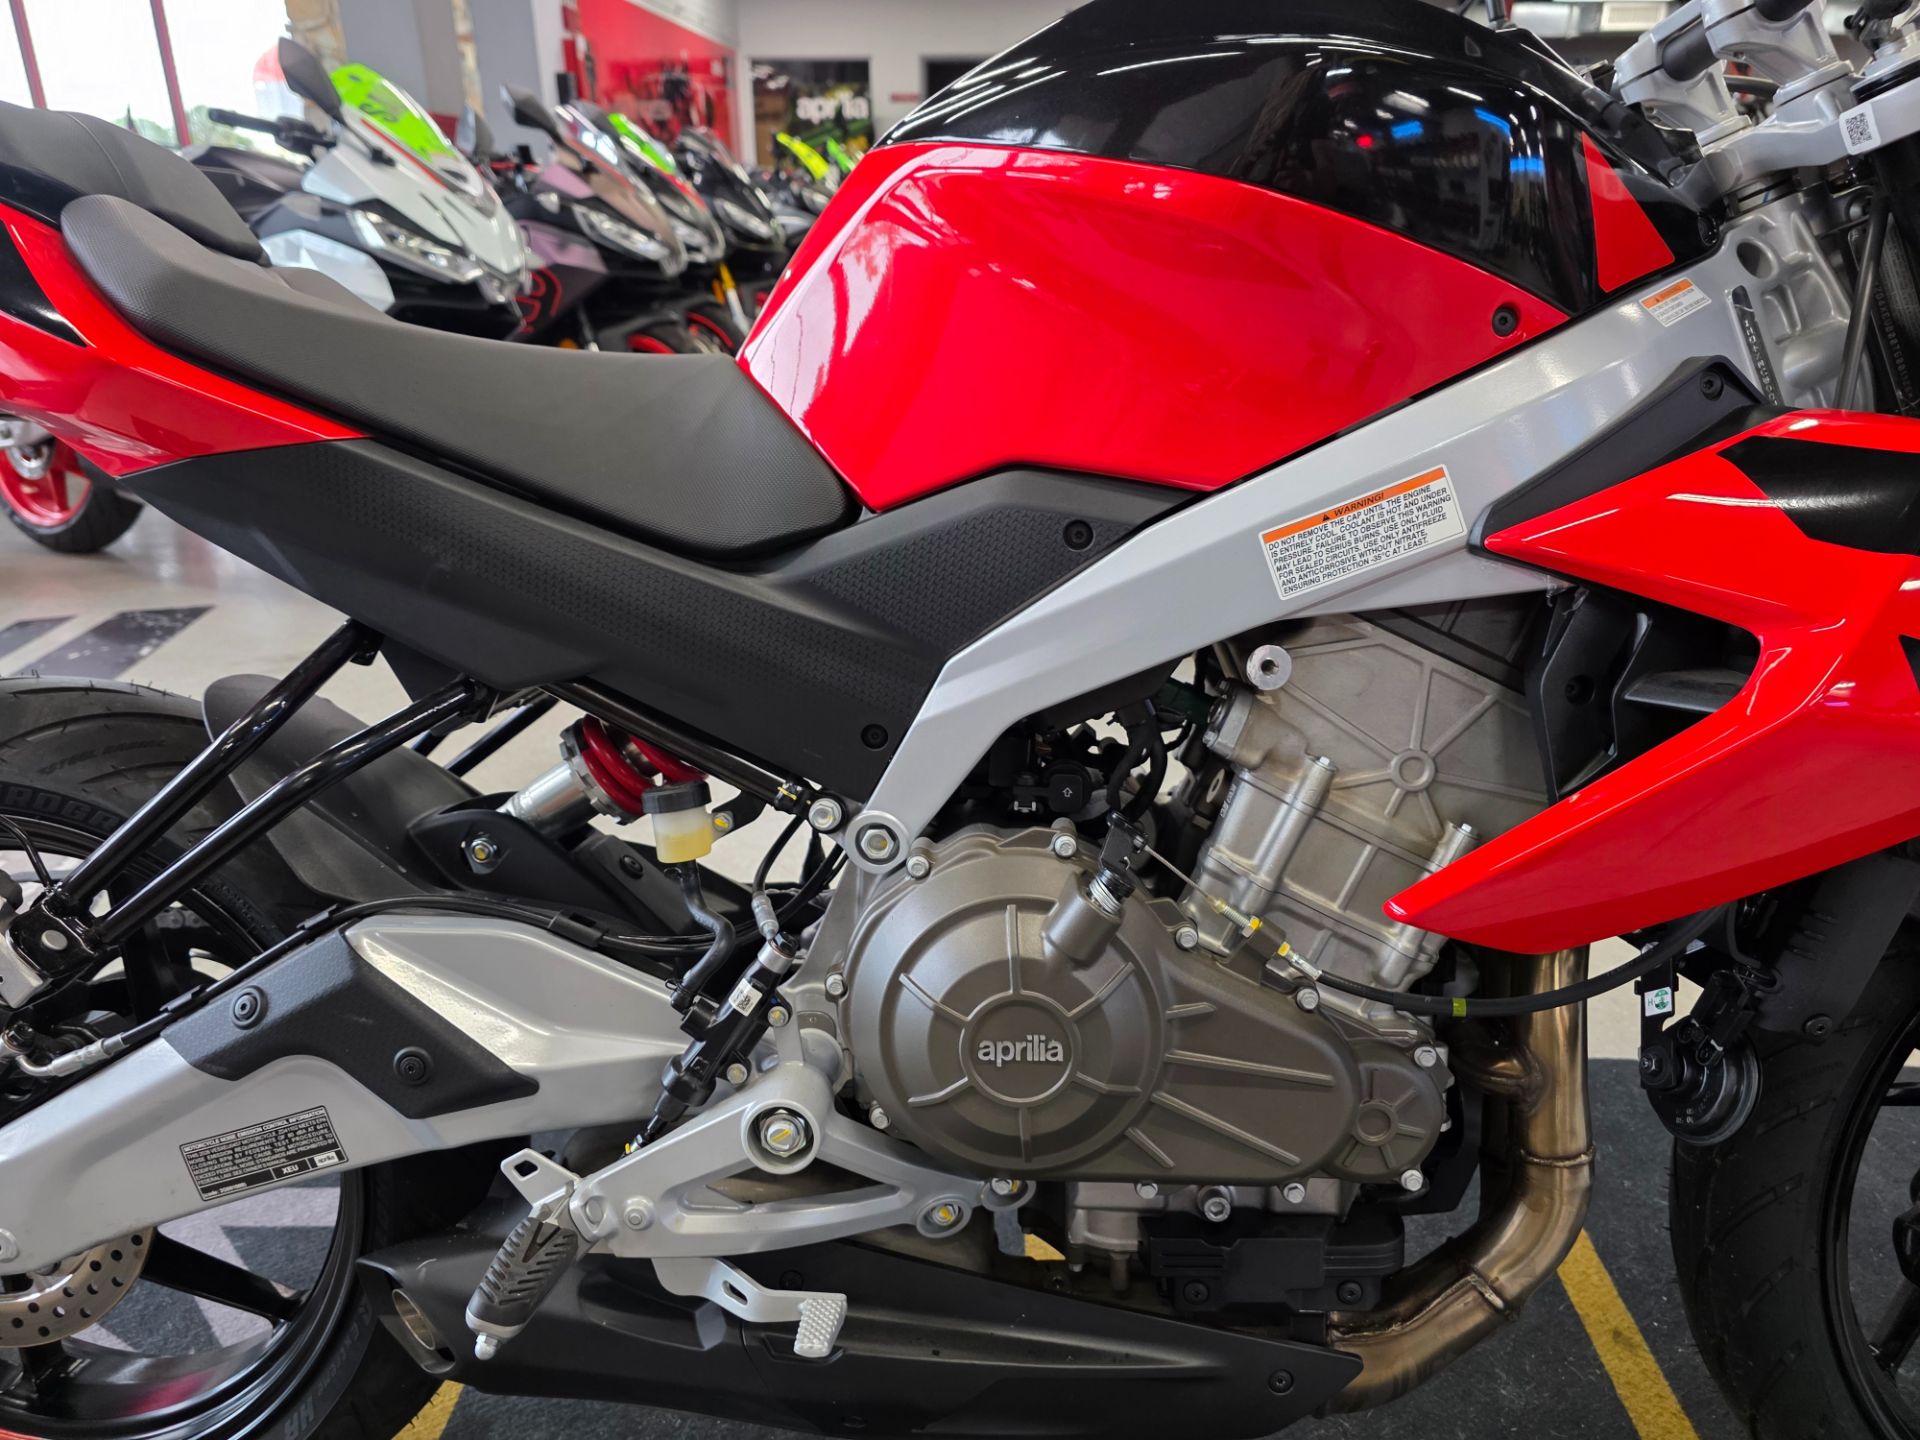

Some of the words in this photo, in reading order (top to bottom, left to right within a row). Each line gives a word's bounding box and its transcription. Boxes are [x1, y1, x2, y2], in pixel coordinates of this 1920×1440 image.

[1270, 542, 1278, 551] DO
[1281, 535, 1295, 546] NOT
[1298, 523, 1328, 540] REMOVE
[1331, 517, 1344, 528] THE
[1347, 511, 1360, 522] CAP
[1364, 502, 1383, 515] UNTIL
[1387, 496, 1400, 507] THE
[1404, 485, 1430, 500] ENGINE
[1272, 550, 1277, 558] IS
[1280, 537, 1312, 555] ENTIRELY
[1316, 528, 1336, 542] COOL.
[1340, 514, 1375, 533] COOLANT
[1378, 511, 1383, 519] IS
[1386, 504, 1401, 515] HOT
[1404, 498, 1418, 509] AND
[1422, 487, 1446, 502] UNDER
[1274, 545, 1313, 566] PRESSURE.
[1316, 533, 1345, 550] FAILURE
[1349, 529, 1357, 538] TO
[1361, 515, 1395, 533] OBSERVE
[1398, 508, 1413, 519] THIS
[1416, 494, 1450, 513] WARNING
[1335, 493, 1383, 516] WARNING!
[1277, 562, 1291, 573] MAY
[1293, 555, 1311, 567] LEAD
[1314, 550, 1322, 559] TO
[1326, 540, 1351, 555] SERIUS
[1384, 522, 1397, 533] USE
[1401, 514, 1419, 527] ONLY
[1422, 505, 1442, 519] FLUID
[1280, 569, 1292, 580] FOR
[1296, 558, 1322, 574] SEALED
[1326, 544, 1360, 563] CIRCUITS.
[1364, 538, 1378, 549] USE
[1381, 530, 1399, 542] ONLY
[1402, 513, 1446, 535] ANTIFREEZE
[1282, 576, 1295, 587] AND
[1299, 554, 1356, 581] ANTICORROSIVE
[1360, 541, 1392, 559] WITHOUT
[1285, 576, 1319, 594] ENSURING
[1322, 558, 1368, 581] PROTECTION
[1392, 545, 1402, 555] AT
[1404, 536, 1427, 551] LEAST.
[977, 1034, 1064, 1068] aprilia
[282, 1164, 299, 1174] XEU
